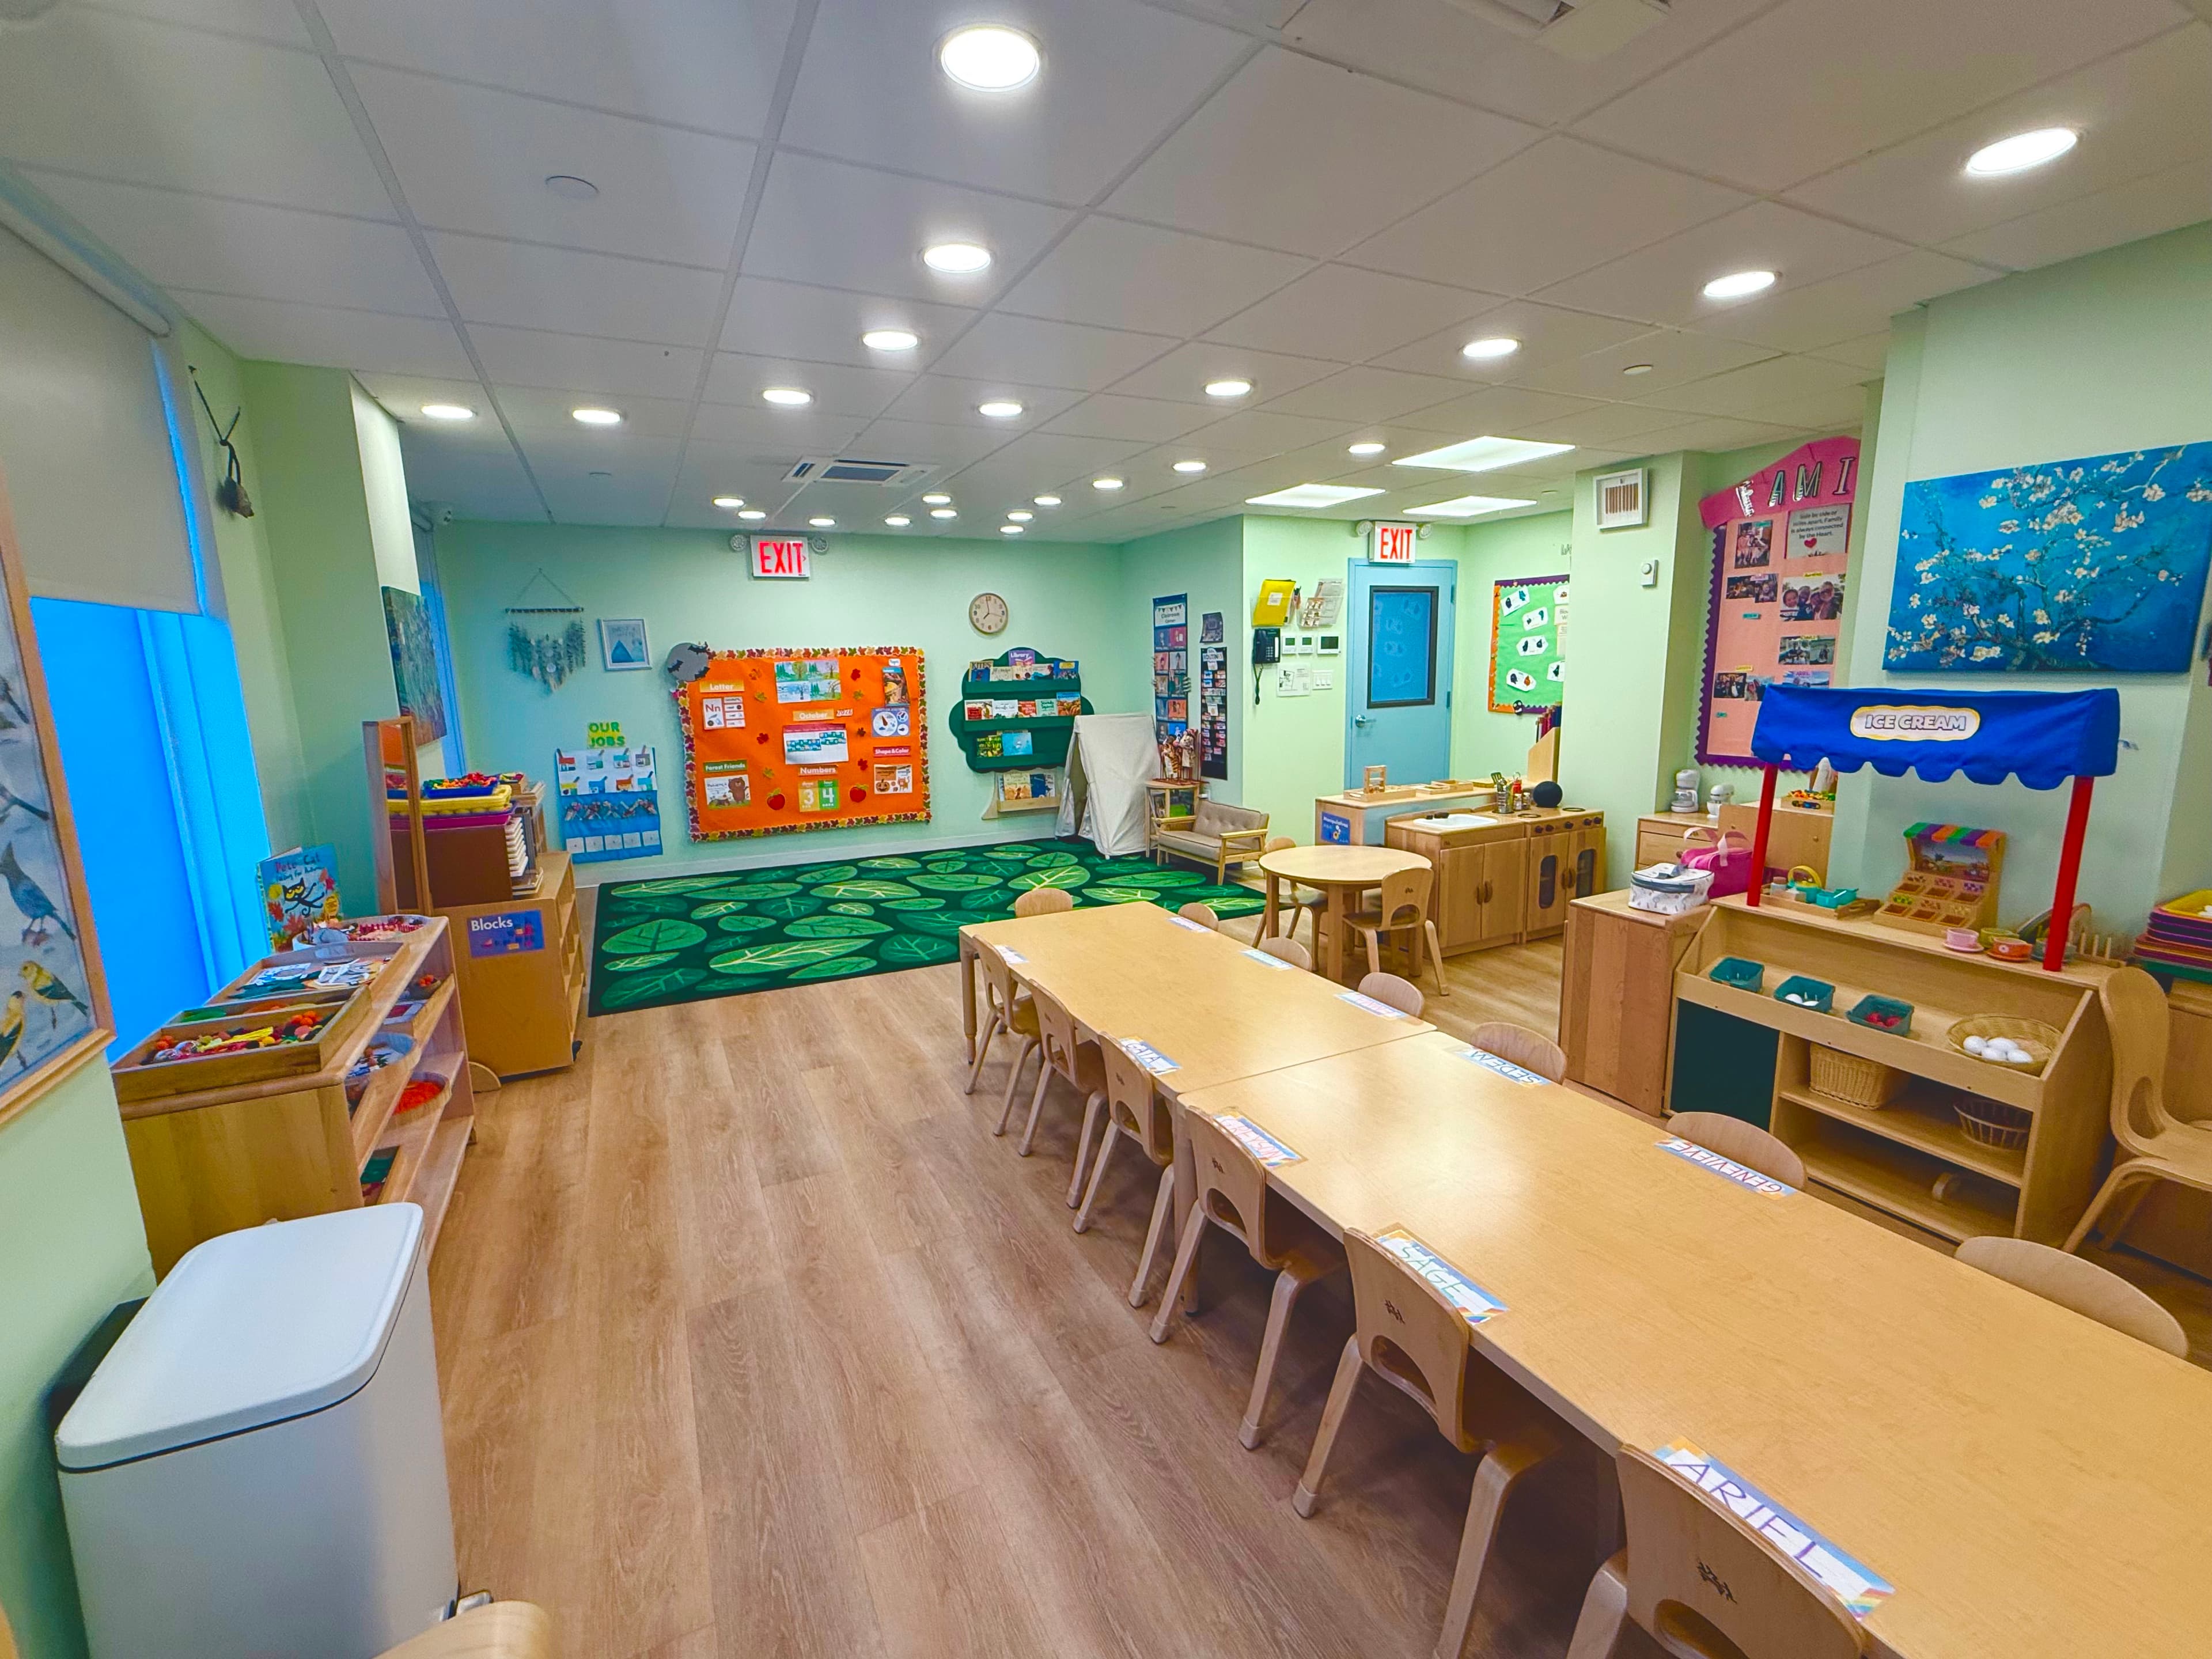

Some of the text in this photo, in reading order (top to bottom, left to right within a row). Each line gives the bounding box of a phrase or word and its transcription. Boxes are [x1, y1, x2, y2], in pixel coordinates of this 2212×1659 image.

[1815, 522, 1843, 530] connected
[1380, 528, 1412, 559] EXIT
[758, 541, 804, 574] EXIT
[705, 704, 721, 712] Nn
[589, 722, 620, 733] OUR
[1865, 715, 1967, 731] ICE CREAM
[589, 736, 625, 747] JOBS
[800, 766, 836, 774] Numbers
[804, 787, 834, 804] 3 4
[304, 852, 320, 865] Cat
[471, 916, 513, 931] Blocks
[1470, 1051, 1540, 1083] SEDEM
[1220, 1118, 1284, 1158] GREYSON
[1676, 1142, 1782, 1192] GENEVIEVE
[1400, 1247, 1462, 1298] SAGE
[1671, 1464, 1823, 1578] ARIEL
